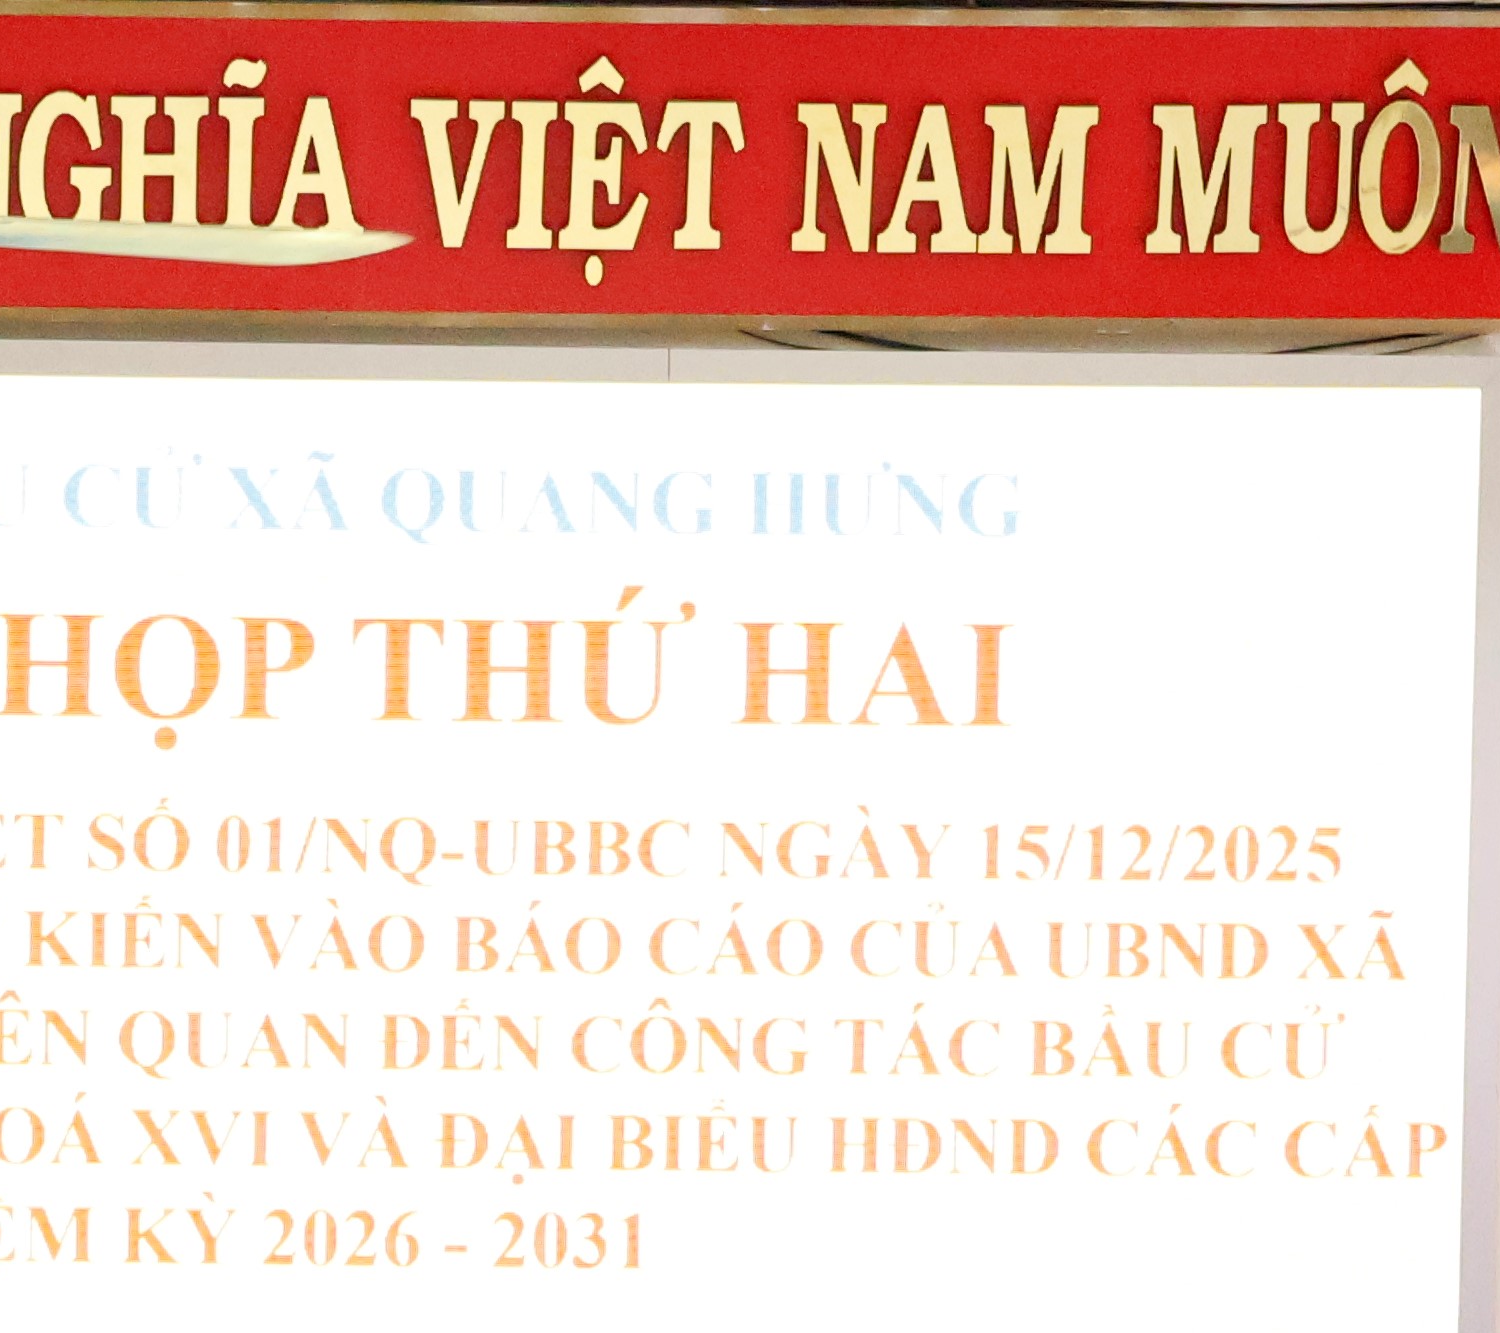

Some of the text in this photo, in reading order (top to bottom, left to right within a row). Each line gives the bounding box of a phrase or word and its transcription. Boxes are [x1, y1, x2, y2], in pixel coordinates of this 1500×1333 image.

[410, 55, 746, 288] VIỆT
[791, 103, 1099, 257] NAM
[225, 449, 349, 532] XÃ
[380, 467, 713, 544] QUANG
[750, 461, 1020, 537] HƯNG
[351, 584, 697, 727] THỨ
[735, 621, 1014, 727] HAI
[87, 796, 191, 873] SỐ
[215, 815, 691, 886] 01/NQ-UBBC
[719, 804, 952, 881] NGÀY
[982, 823, 1342, 885] 15/12/2025
[24, 894, 224, 970] KIẾN
[251, 896, 426, 974] VÀO
[455, 899, 623, 976] BÁO
[648, 901, 825, 977] CÁO
[849, 903, 1019, 980] CỦA
[1047, 921, 1270, 981] UBND
[1296, 909, 1408, 982] XÃ
[118, 1009, 349, 1081] QUAN
[380, 997, 543, 1073] ĐẾN
[570, 996, 809, 1077] CÔNG
[833, 1001, 1001, 1078] TÁC
[1030, 1003, 1193, 1080] BẦU
[1219, 1004, 1347, 1081] CỬ
[130, 1108, 271, 1168] XVI
[300, 1094, 410, 1169] VÀ
[436, 1112, 576, 1186] ĐẠI
[608, 1105, 799, 1174] BIỂU
[829, 1116, 1060, 1176] HĐND
[1085, 1102, 1257, 1178] CÁC
[1283, 1103, 1449, 1180] CẤP
[123, 1196, 237, 1266] KỲ
[263, 1208, 421, 1269] 2026
[492, 1210, 641, 1271] 2031
